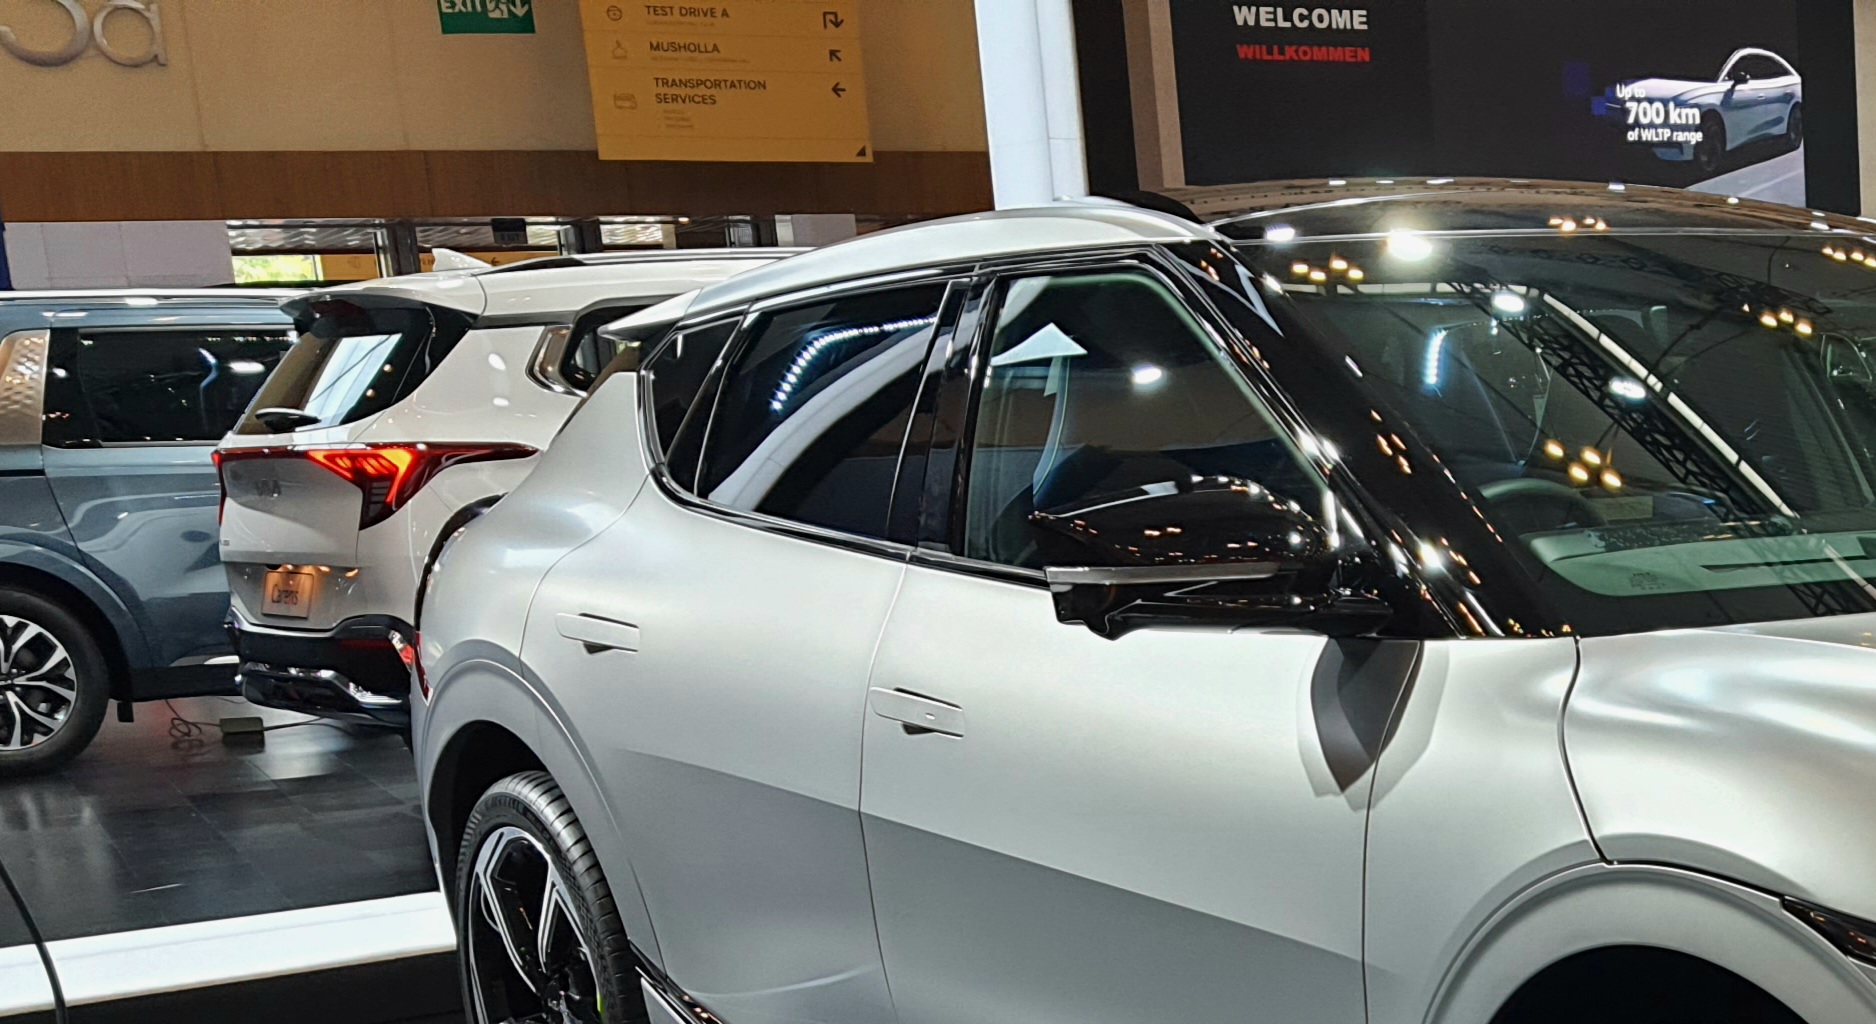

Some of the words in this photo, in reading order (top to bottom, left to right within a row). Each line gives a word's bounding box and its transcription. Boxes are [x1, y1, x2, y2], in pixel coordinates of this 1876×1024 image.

[644, 6, 677, 17] TEST
[679, 7, 718, 18] DRIVE
[720, 8, 730, 19] A
[1233, 5, 1368, 30] WELCOME
[650, 41, 721, 54] MUSHOLLA
[1236, 44, 1371, 62] WILLKOMMEN
[654, 77, 767, 91] TRANSPORTATION
[1616, 83, 1632, 101] Up
[1634, 86, 1646, 98] to
[655, 93, 717, 105] SERVICES
[1625, 101, 1665, 125] 700
[1669, 101, 1701, 125] km
[1627, 127, 1640, 141] of
[1641, 127, 1671, 141] WLTP
[1672, 131, 1703, 145] range
